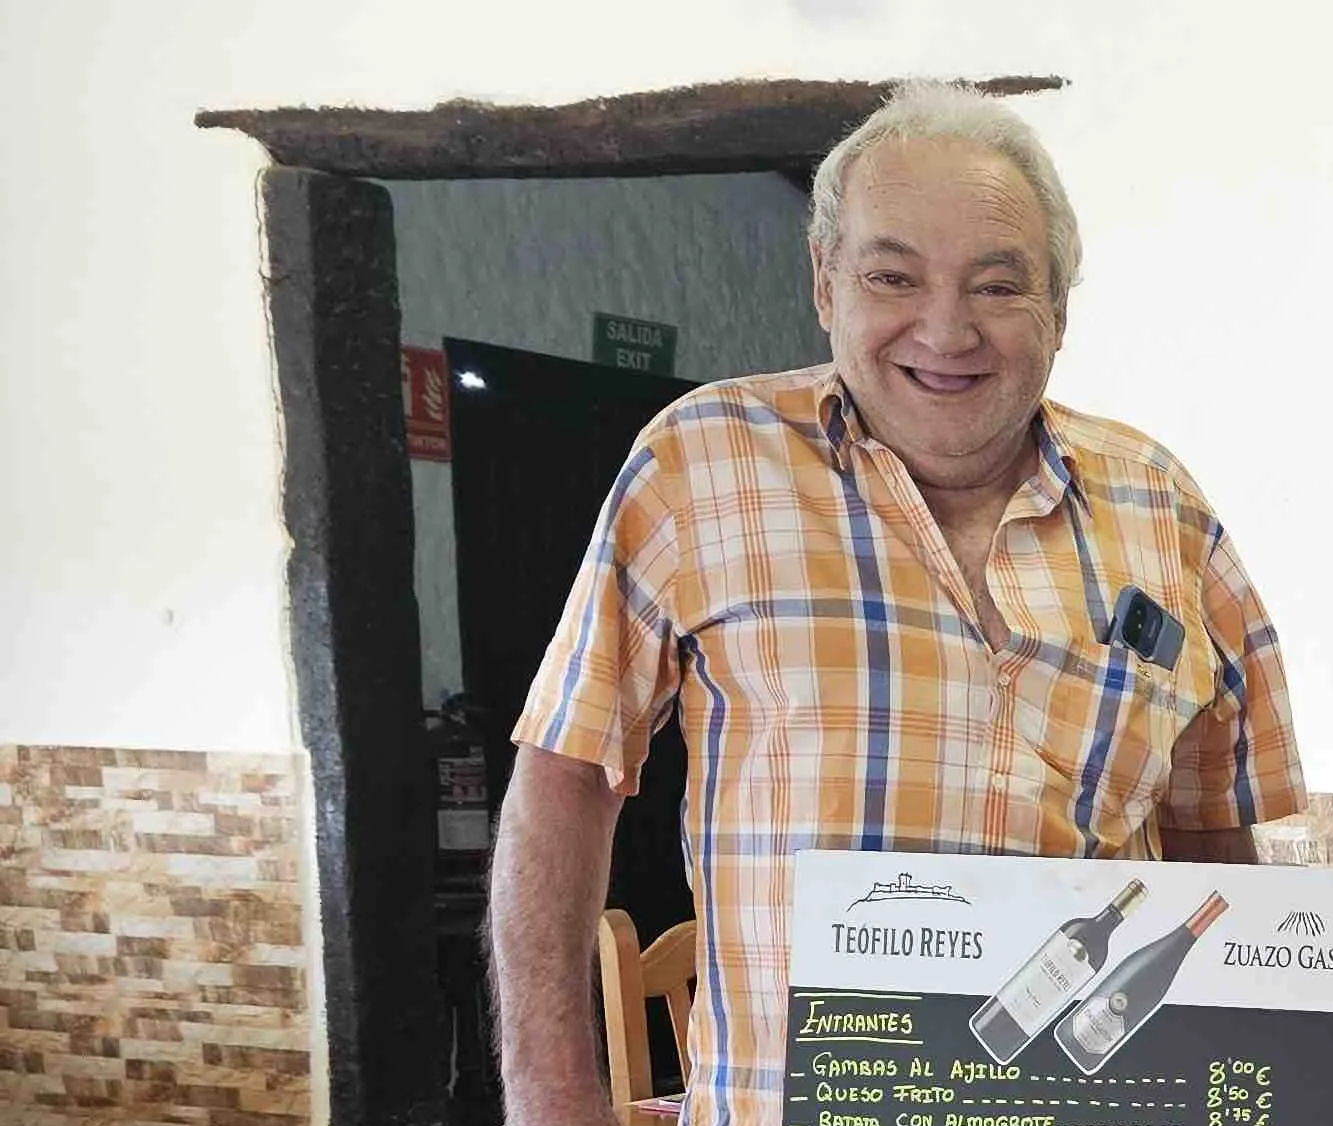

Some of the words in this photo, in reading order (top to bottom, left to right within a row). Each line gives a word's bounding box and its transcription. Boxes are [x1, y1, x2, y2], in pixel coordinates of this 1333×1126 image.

[607, 320, 664, 348] SALIDA
[616, 348, 652, 370] EXIT
[831, 922, 914, 956] TEÓFILO
[919, 927, 983, 960] REYES
[1223, 942, 1292, 968] ZUAZO
[800, 1000, 913, 1034] ENTRANTES
[813, 1052, 897, 1077] GAMBAS
[909, 1058, 934, 1077] AL
[950, 1060, 1020, 1083] AJILLO
[816, 1083, 882, 1102] QUESO
[893, 1085, 954, 1103] FRITO
